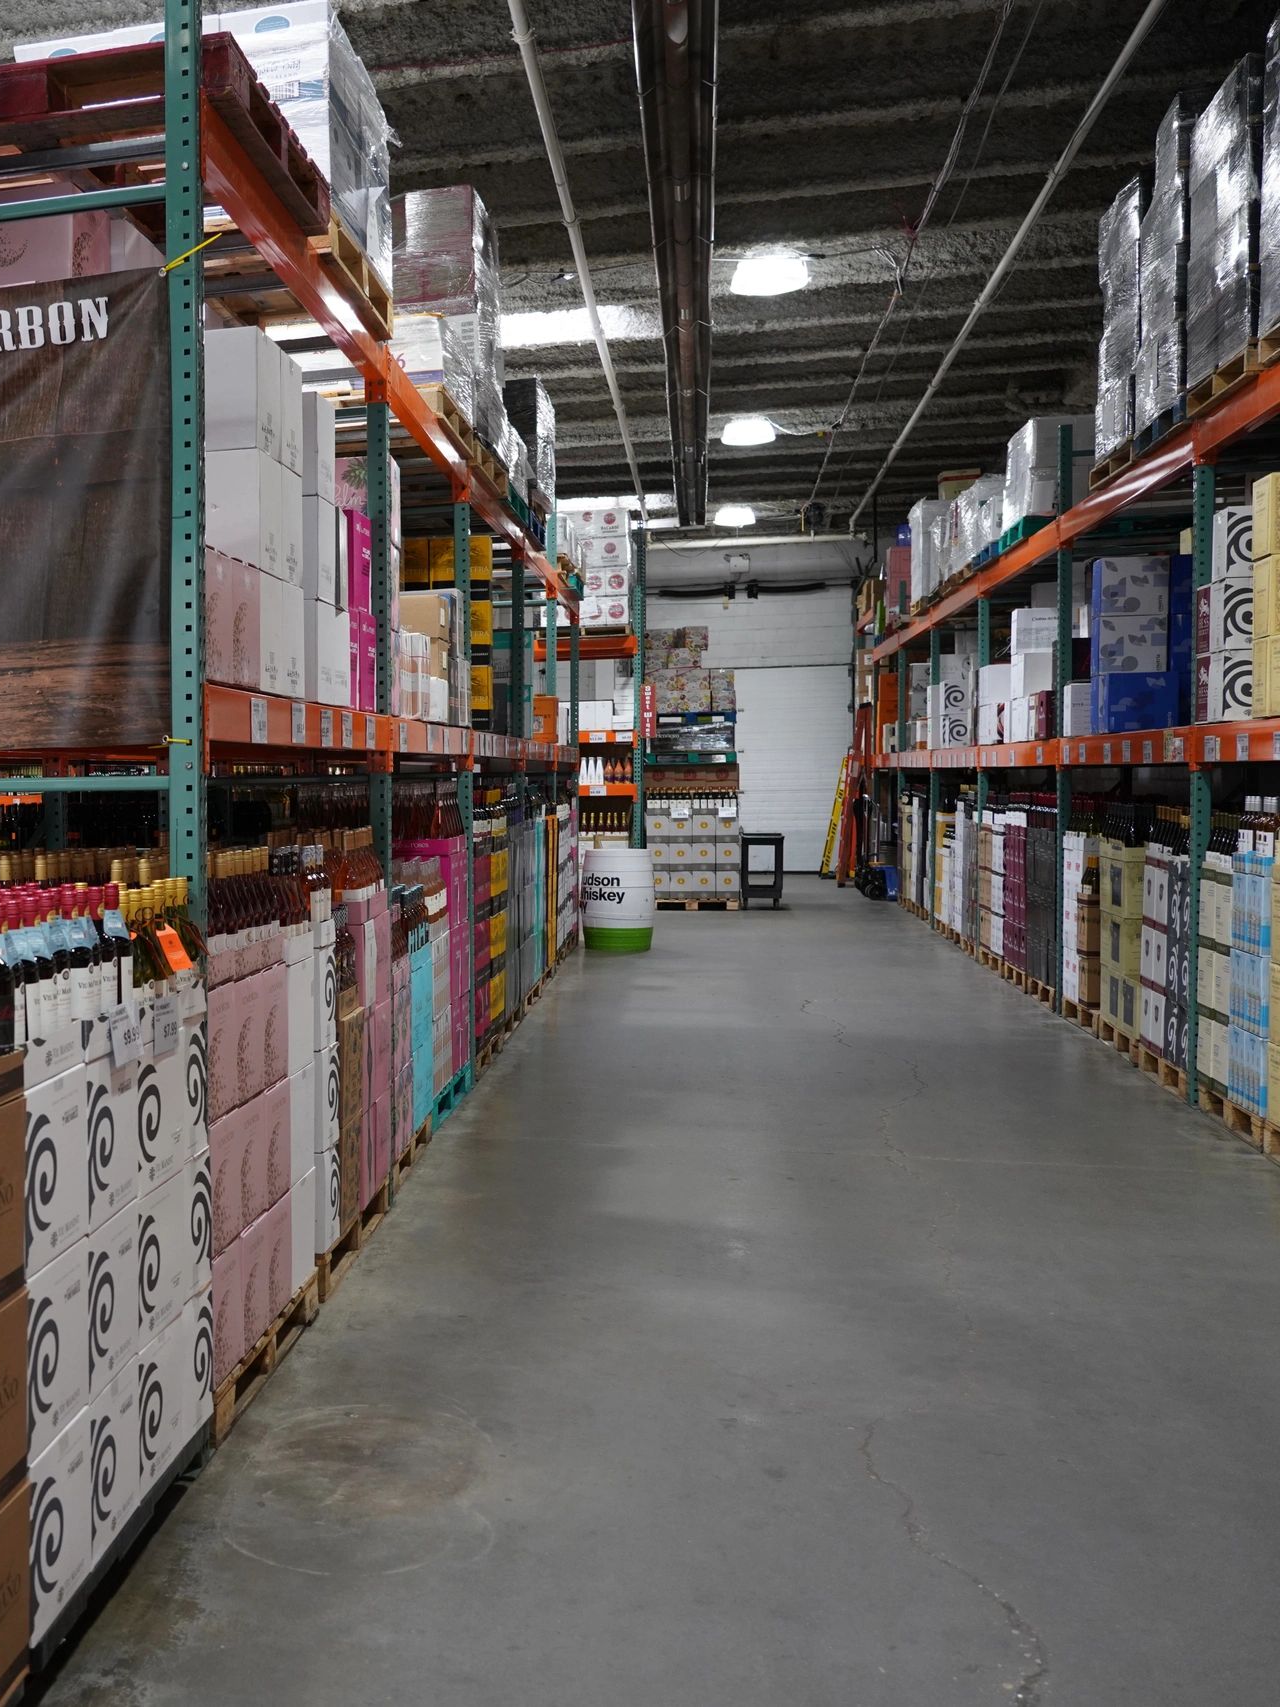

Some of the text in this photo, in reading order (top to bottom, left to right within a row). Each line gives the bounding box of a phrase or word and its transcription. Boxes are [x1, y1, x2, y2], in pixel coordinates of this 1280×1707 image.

[643, 685, 652, 738] Sweet Wines
[582, 872, 620, 887] udson
[581, 887, 625, 905] hiskey
[123, 1026, 141, 1046] $9.99
[163, 1021, 179, 1039] $7.99
